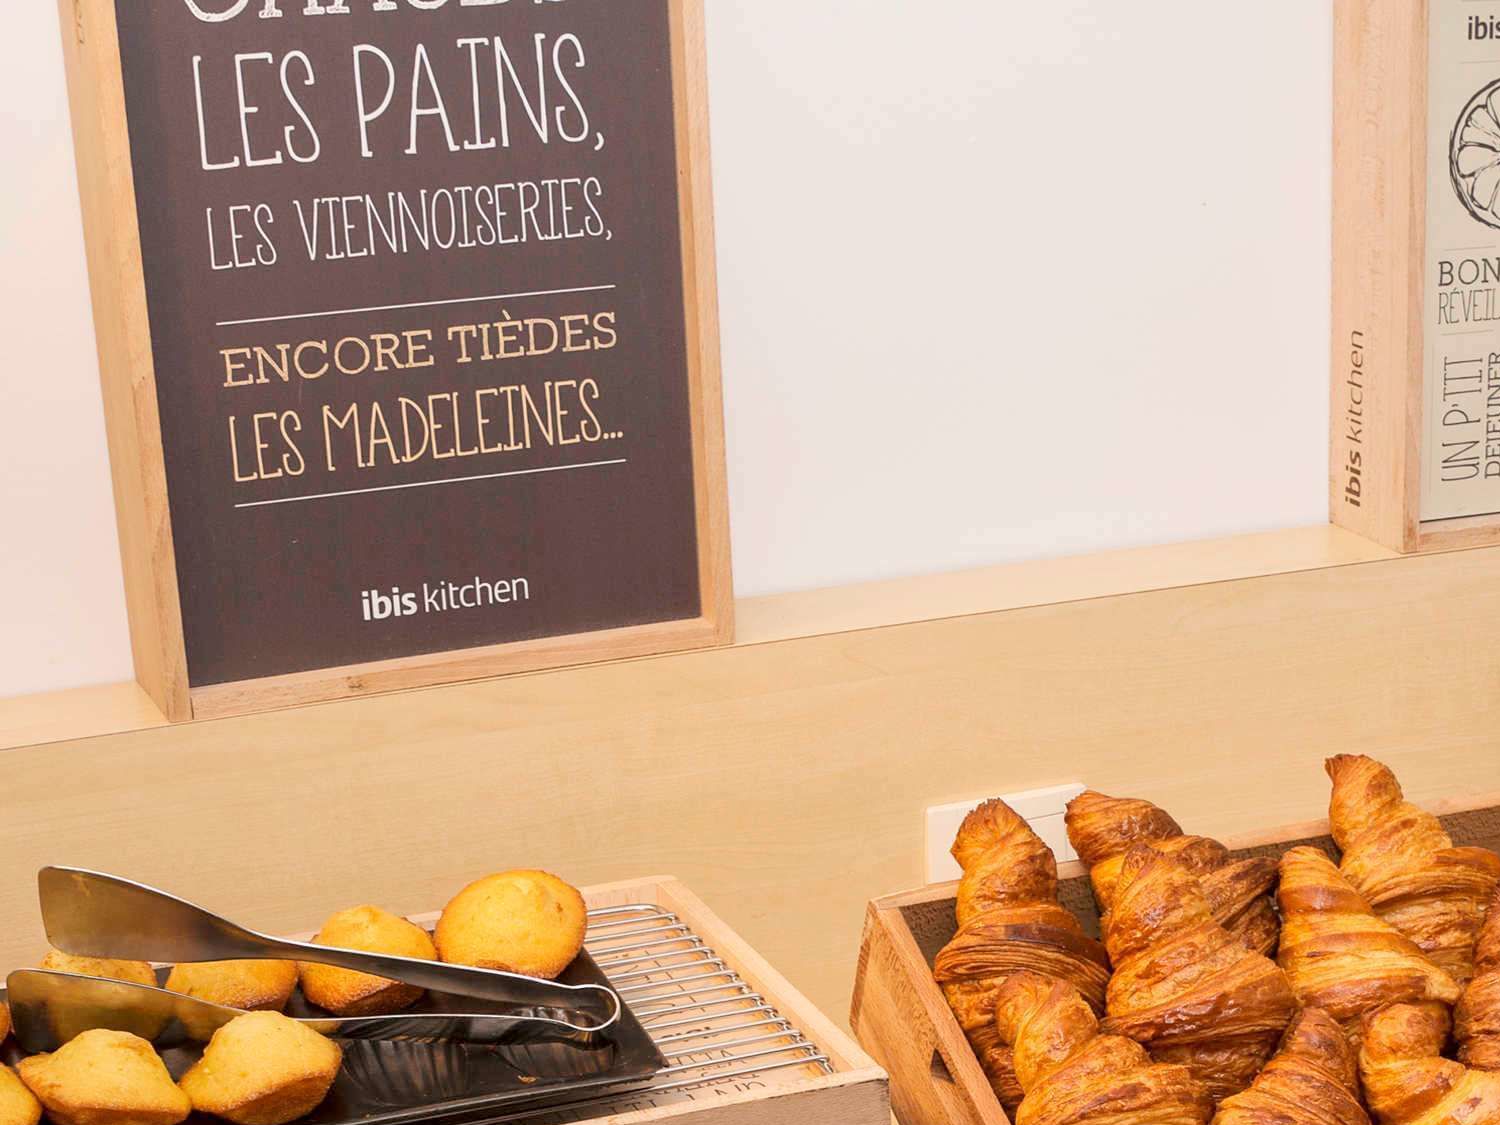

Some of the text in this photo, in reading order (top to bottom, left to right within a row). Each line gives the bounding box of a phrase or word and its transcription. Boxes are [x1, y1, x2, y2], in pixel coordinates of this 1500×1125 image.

[192, 32, 605, 171] LES PAINS,
[206, 176, 612, 270] LES VIENNOISERIES,
[219, 309, 617, 388] ENCORE TIÈDES
[229, 379, 624, 482] LES MADELEINES...
[1344, 330, 1364, 507] ibis kitchen
[1440, 356, 1483, 482] UN P'TIT
[361, 576, 529, 621] ibis kitchen
